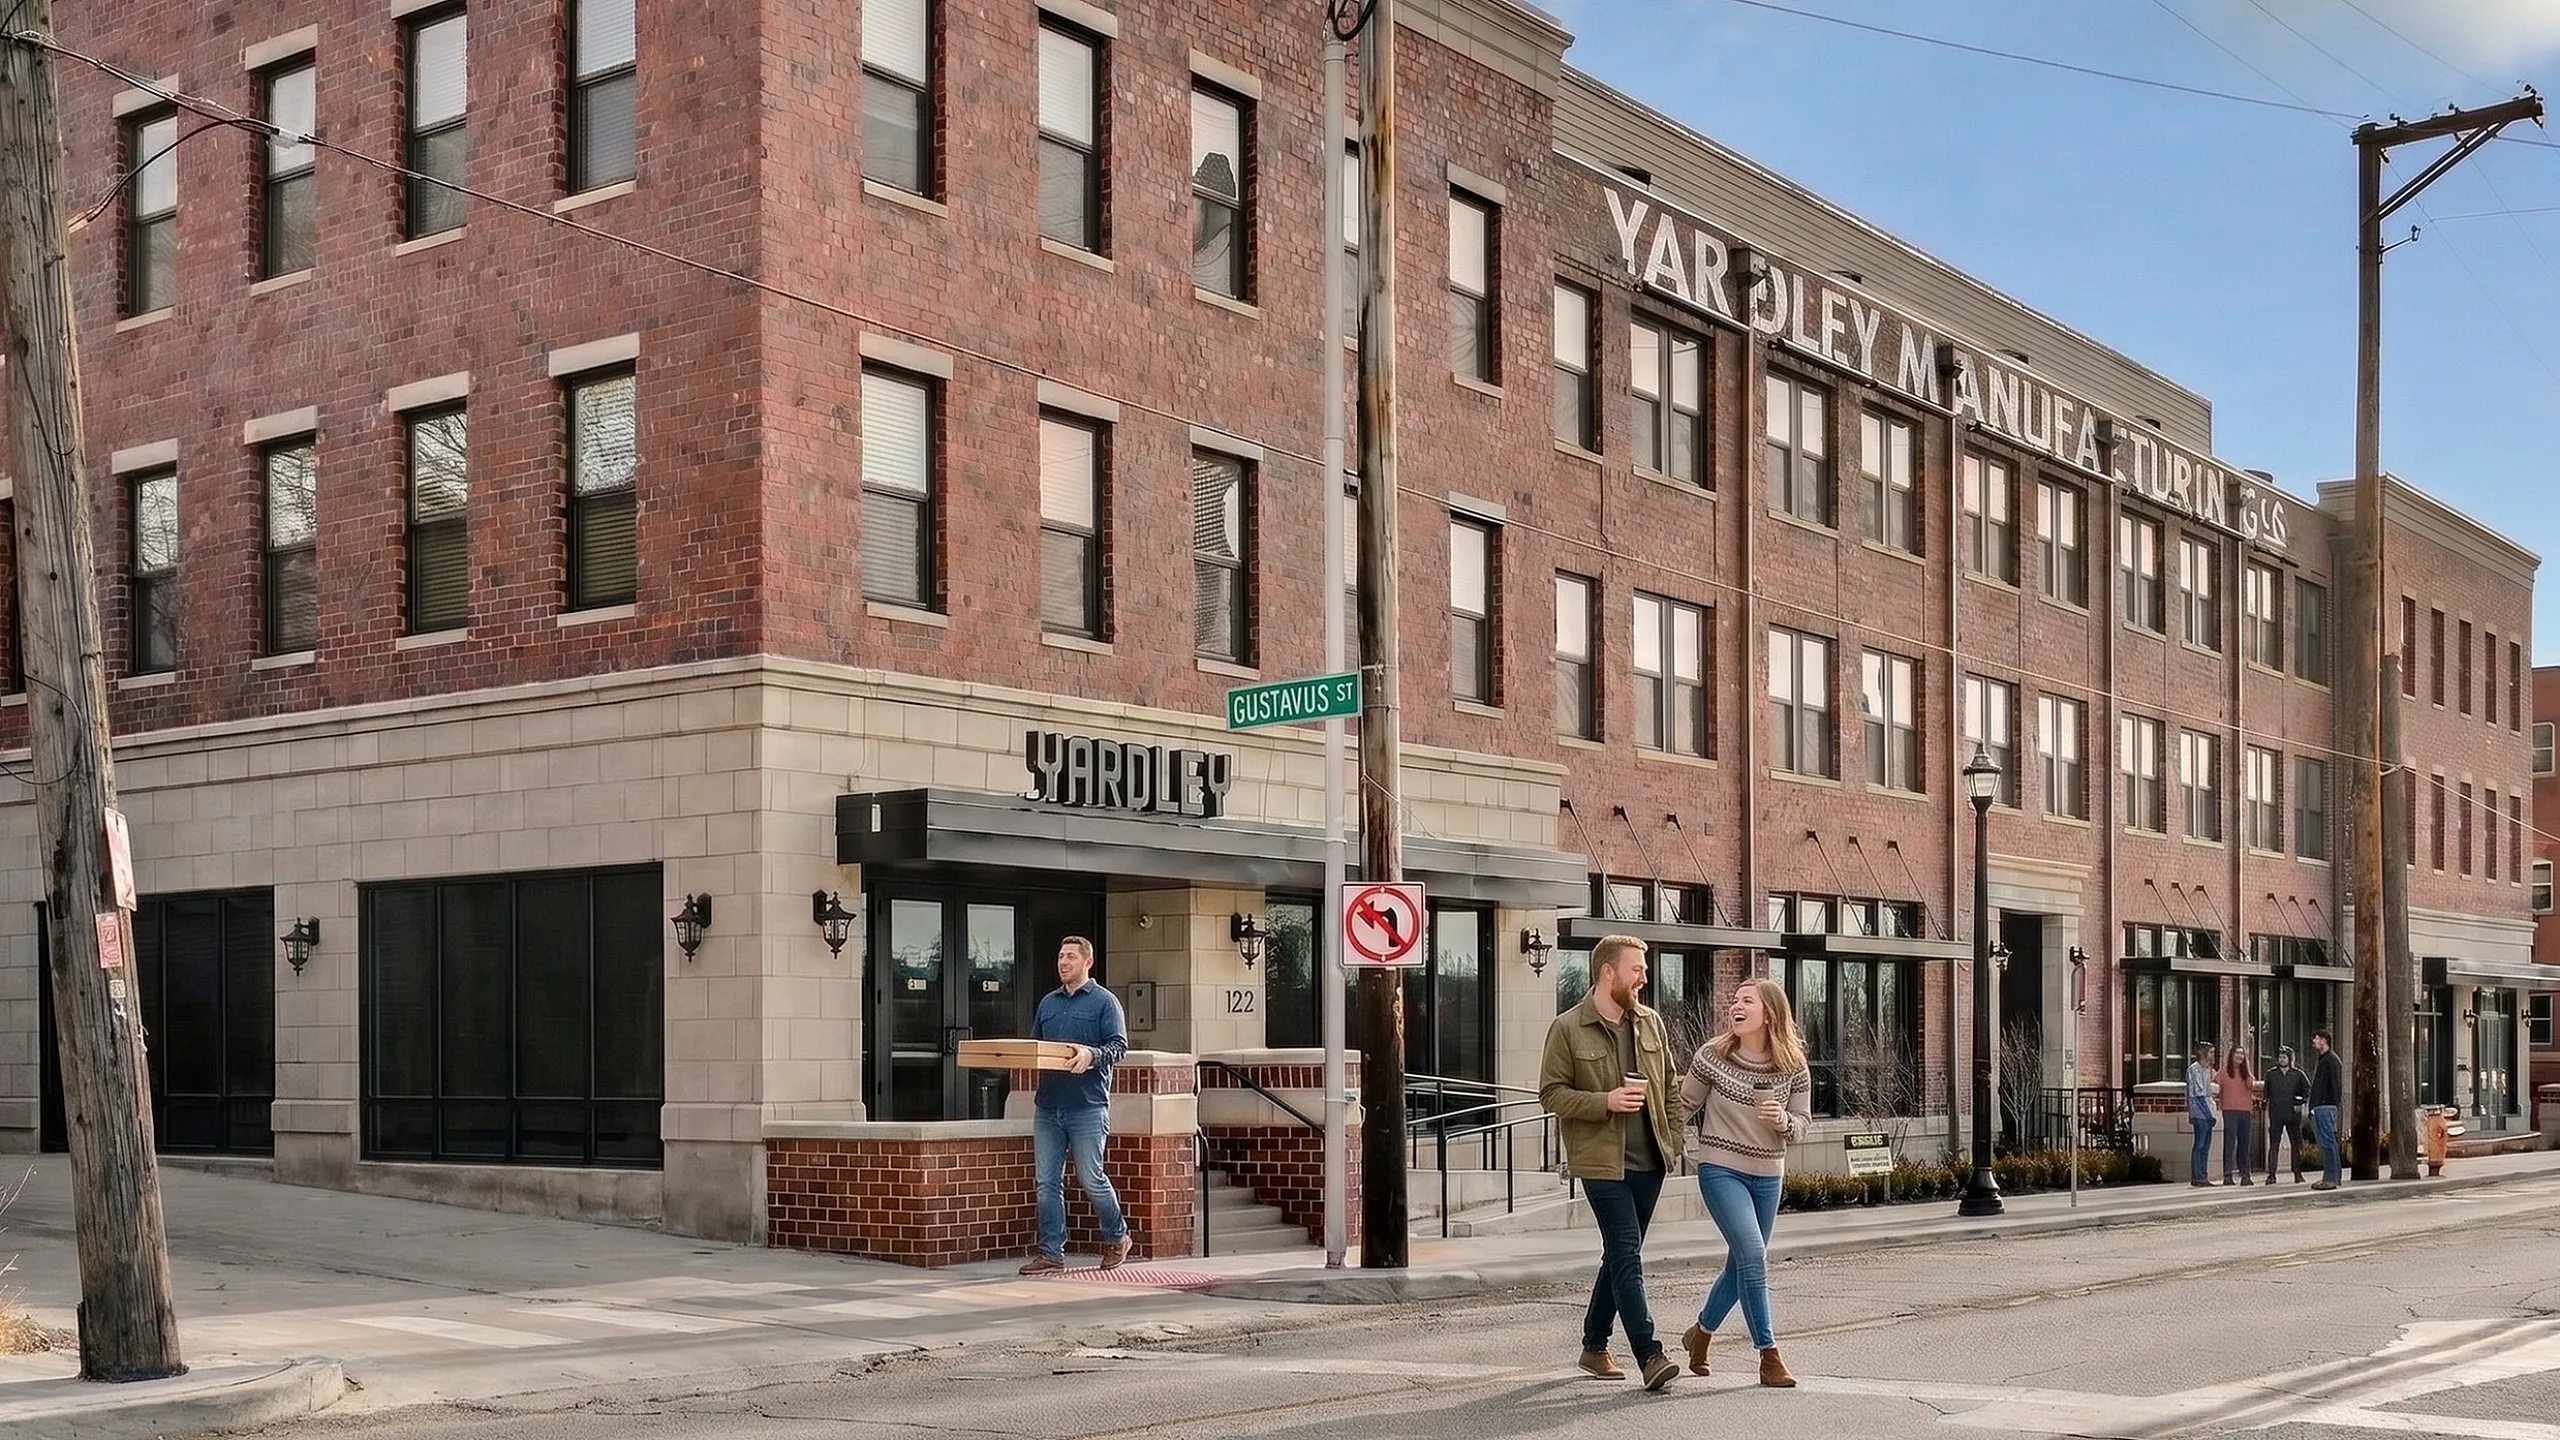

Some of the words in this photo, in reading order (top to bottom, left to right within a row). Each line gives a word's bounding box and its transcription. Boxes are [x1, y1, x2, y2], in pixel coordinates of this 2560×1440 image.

[1603, 184, 1881, 375] YARDLEY
[1233, 683, 1330, 724] GUSTAVUS
[1336, 682, 1353, 702] ST
[1026, 731, 1232, 818] YARDLEY
[1225, 990, 1254, 1013] 122
